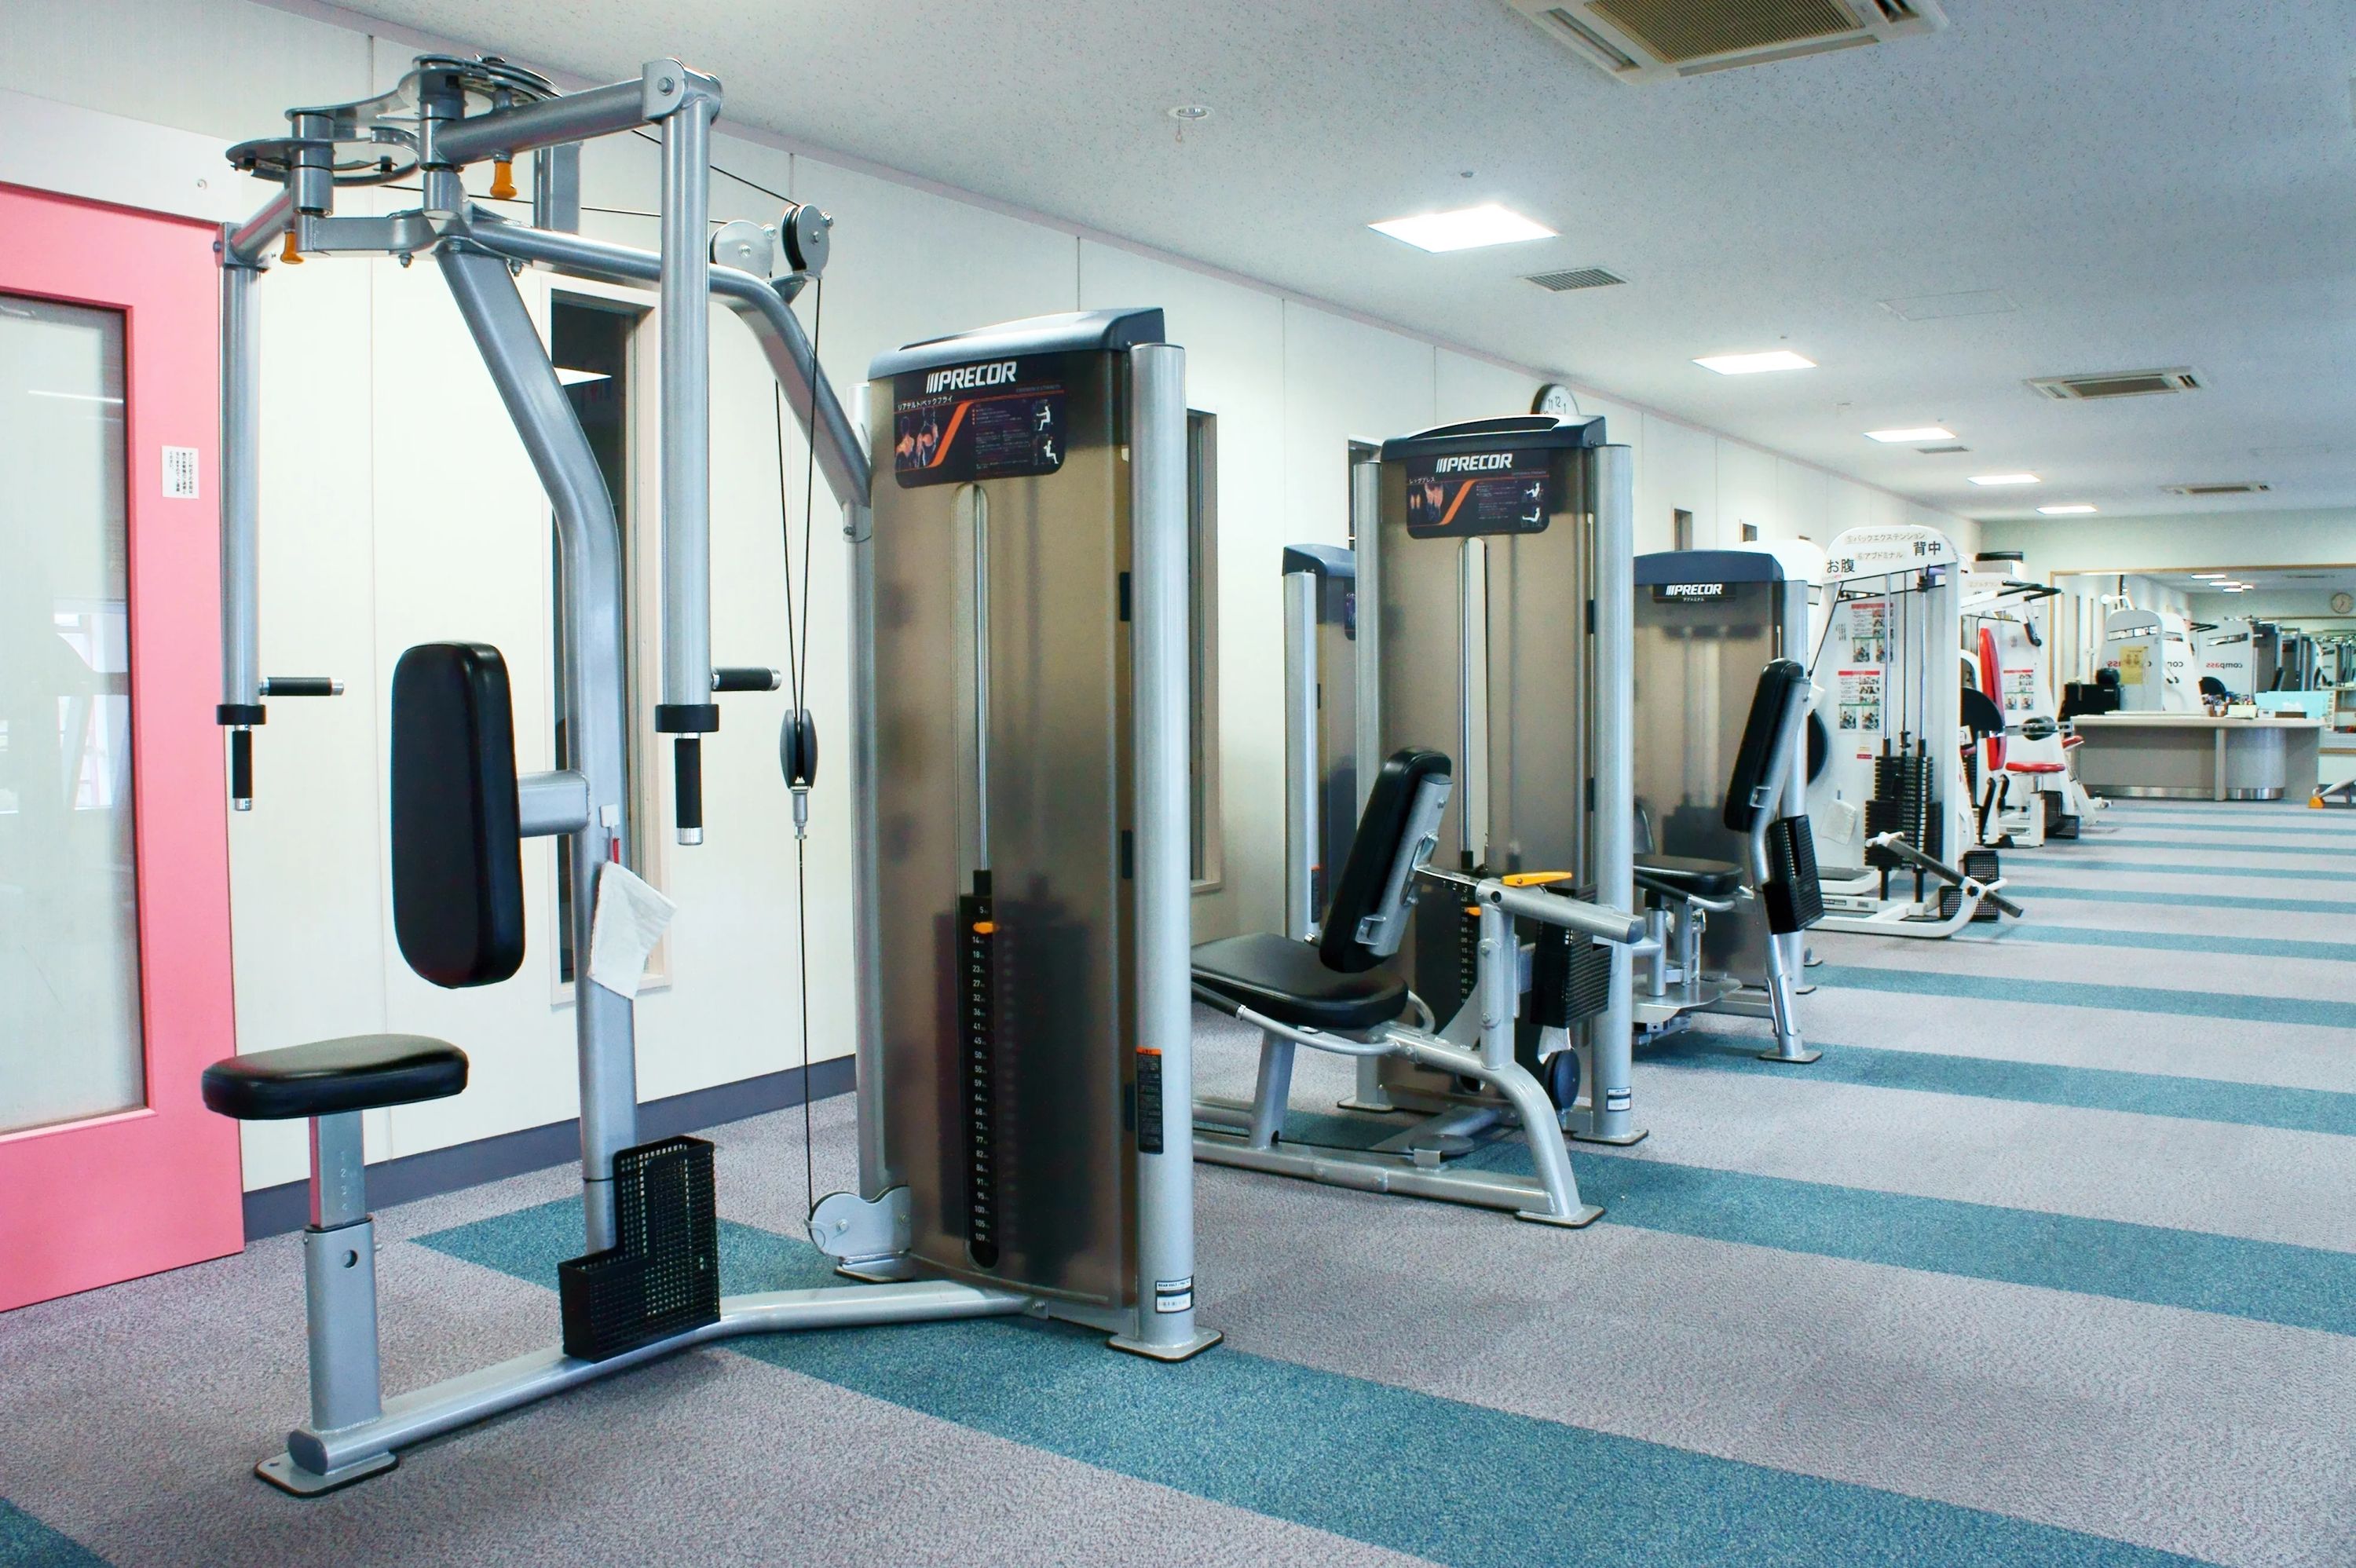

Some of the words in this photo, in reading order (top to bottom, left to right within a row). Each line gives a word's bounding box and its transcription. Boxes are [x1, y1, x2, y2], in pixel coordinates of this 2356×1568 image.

[938, 361, 1017, 393] PRECOR
[1548, 398, 1553, 409] 11
[1555, 396, 1561, 408] 12
[1447, 453, 1513, 473] PRECOR
[1913, 540, 1941, 557] 背中
[1826, 558, 1855, 573] お腹
[1674, 583, 1723, 596] PRECOR
